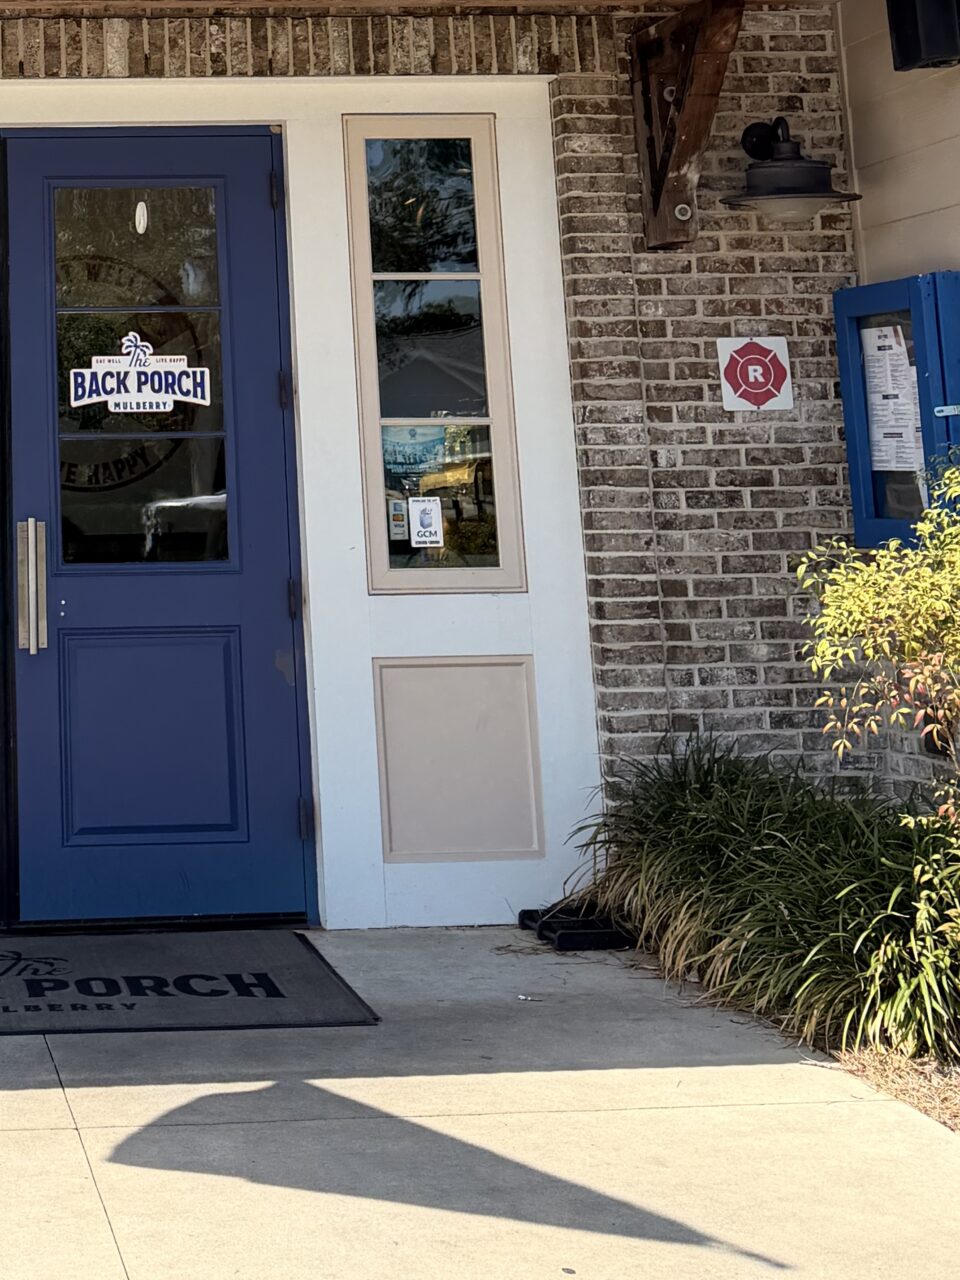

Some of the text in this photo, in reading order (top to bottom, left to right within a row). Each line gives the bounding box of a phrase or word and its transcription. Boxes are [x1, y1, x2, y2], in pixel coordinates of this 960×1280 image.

[747, 365, 766, 383] R
[72, 370, 206, 403] BACK PORCH
[113, 400, 168, 411] MULBERRY
[416, 529, 438, 538] GCM
[22, 972, 288, 999] PORCH
